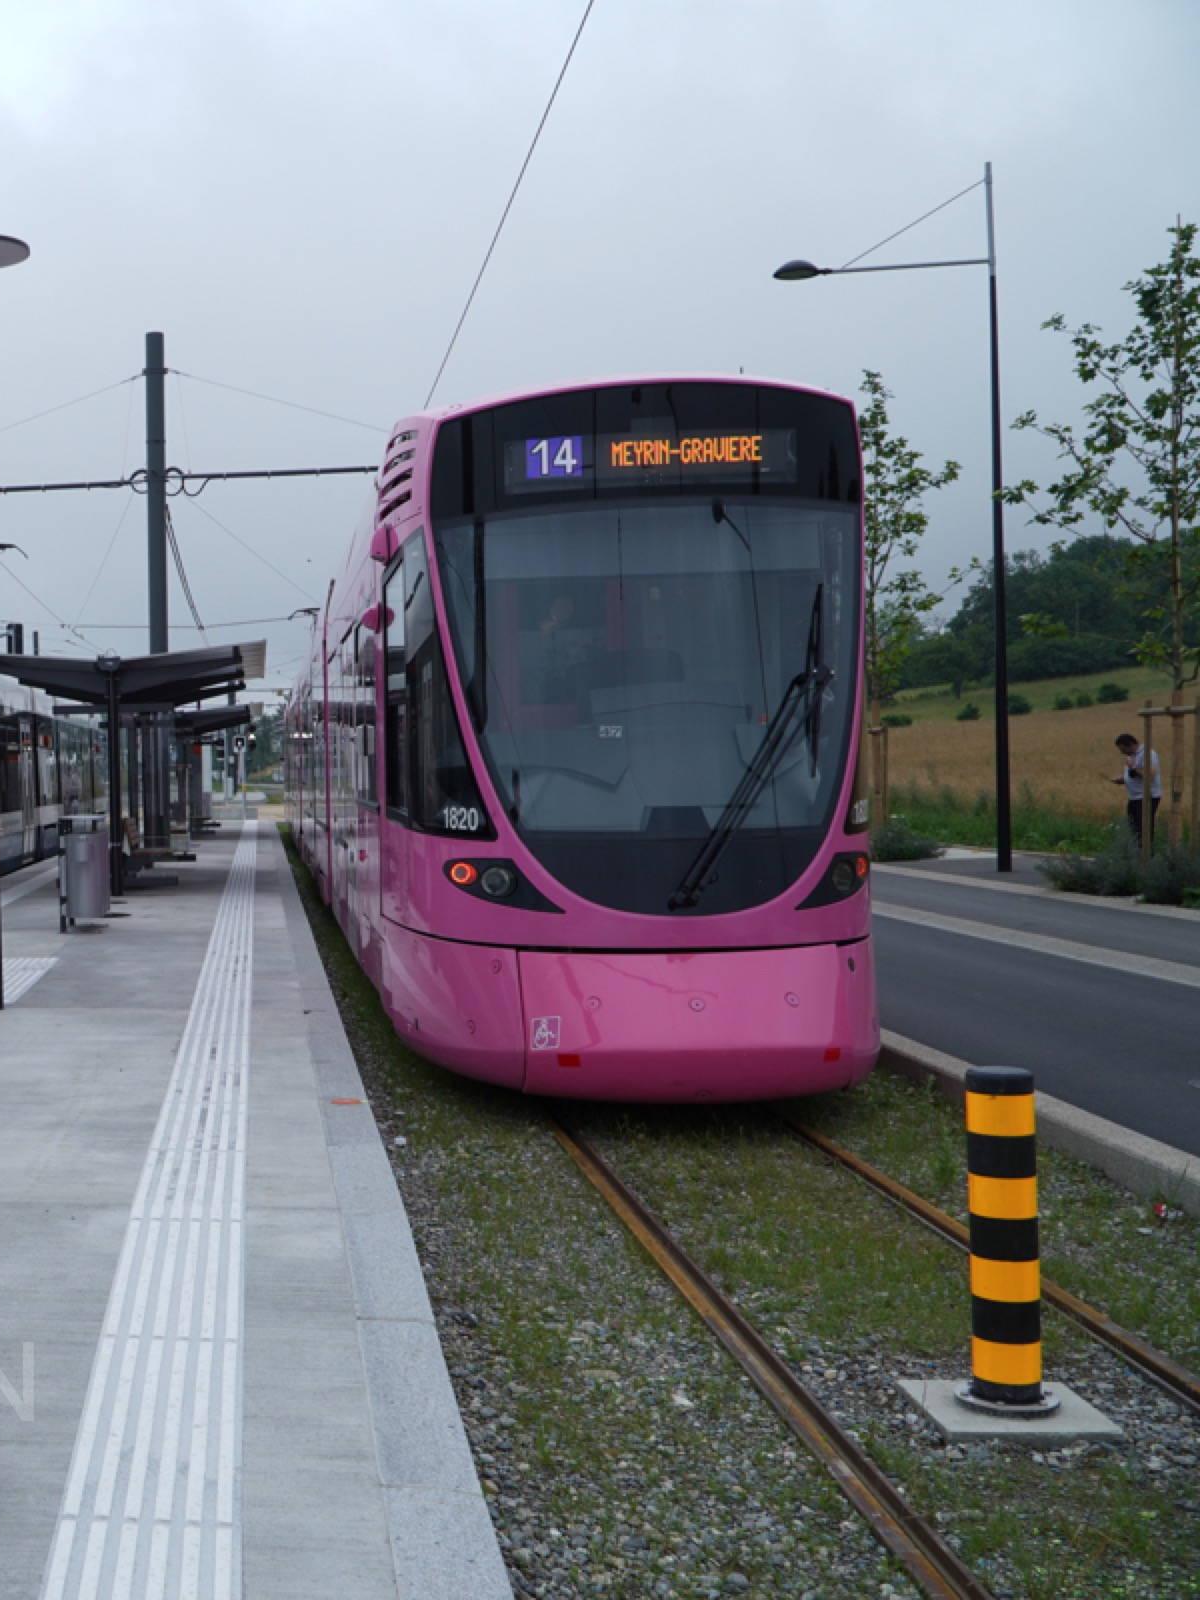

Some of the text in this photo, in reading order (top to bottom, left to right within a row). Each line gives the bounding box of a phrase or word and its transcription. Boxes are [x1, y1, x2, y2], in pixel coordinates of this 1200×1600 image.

[531, 435, 763, 476] 14 MEYRIN-GRAVIERE
[443, 805, 479, 831] 1820
